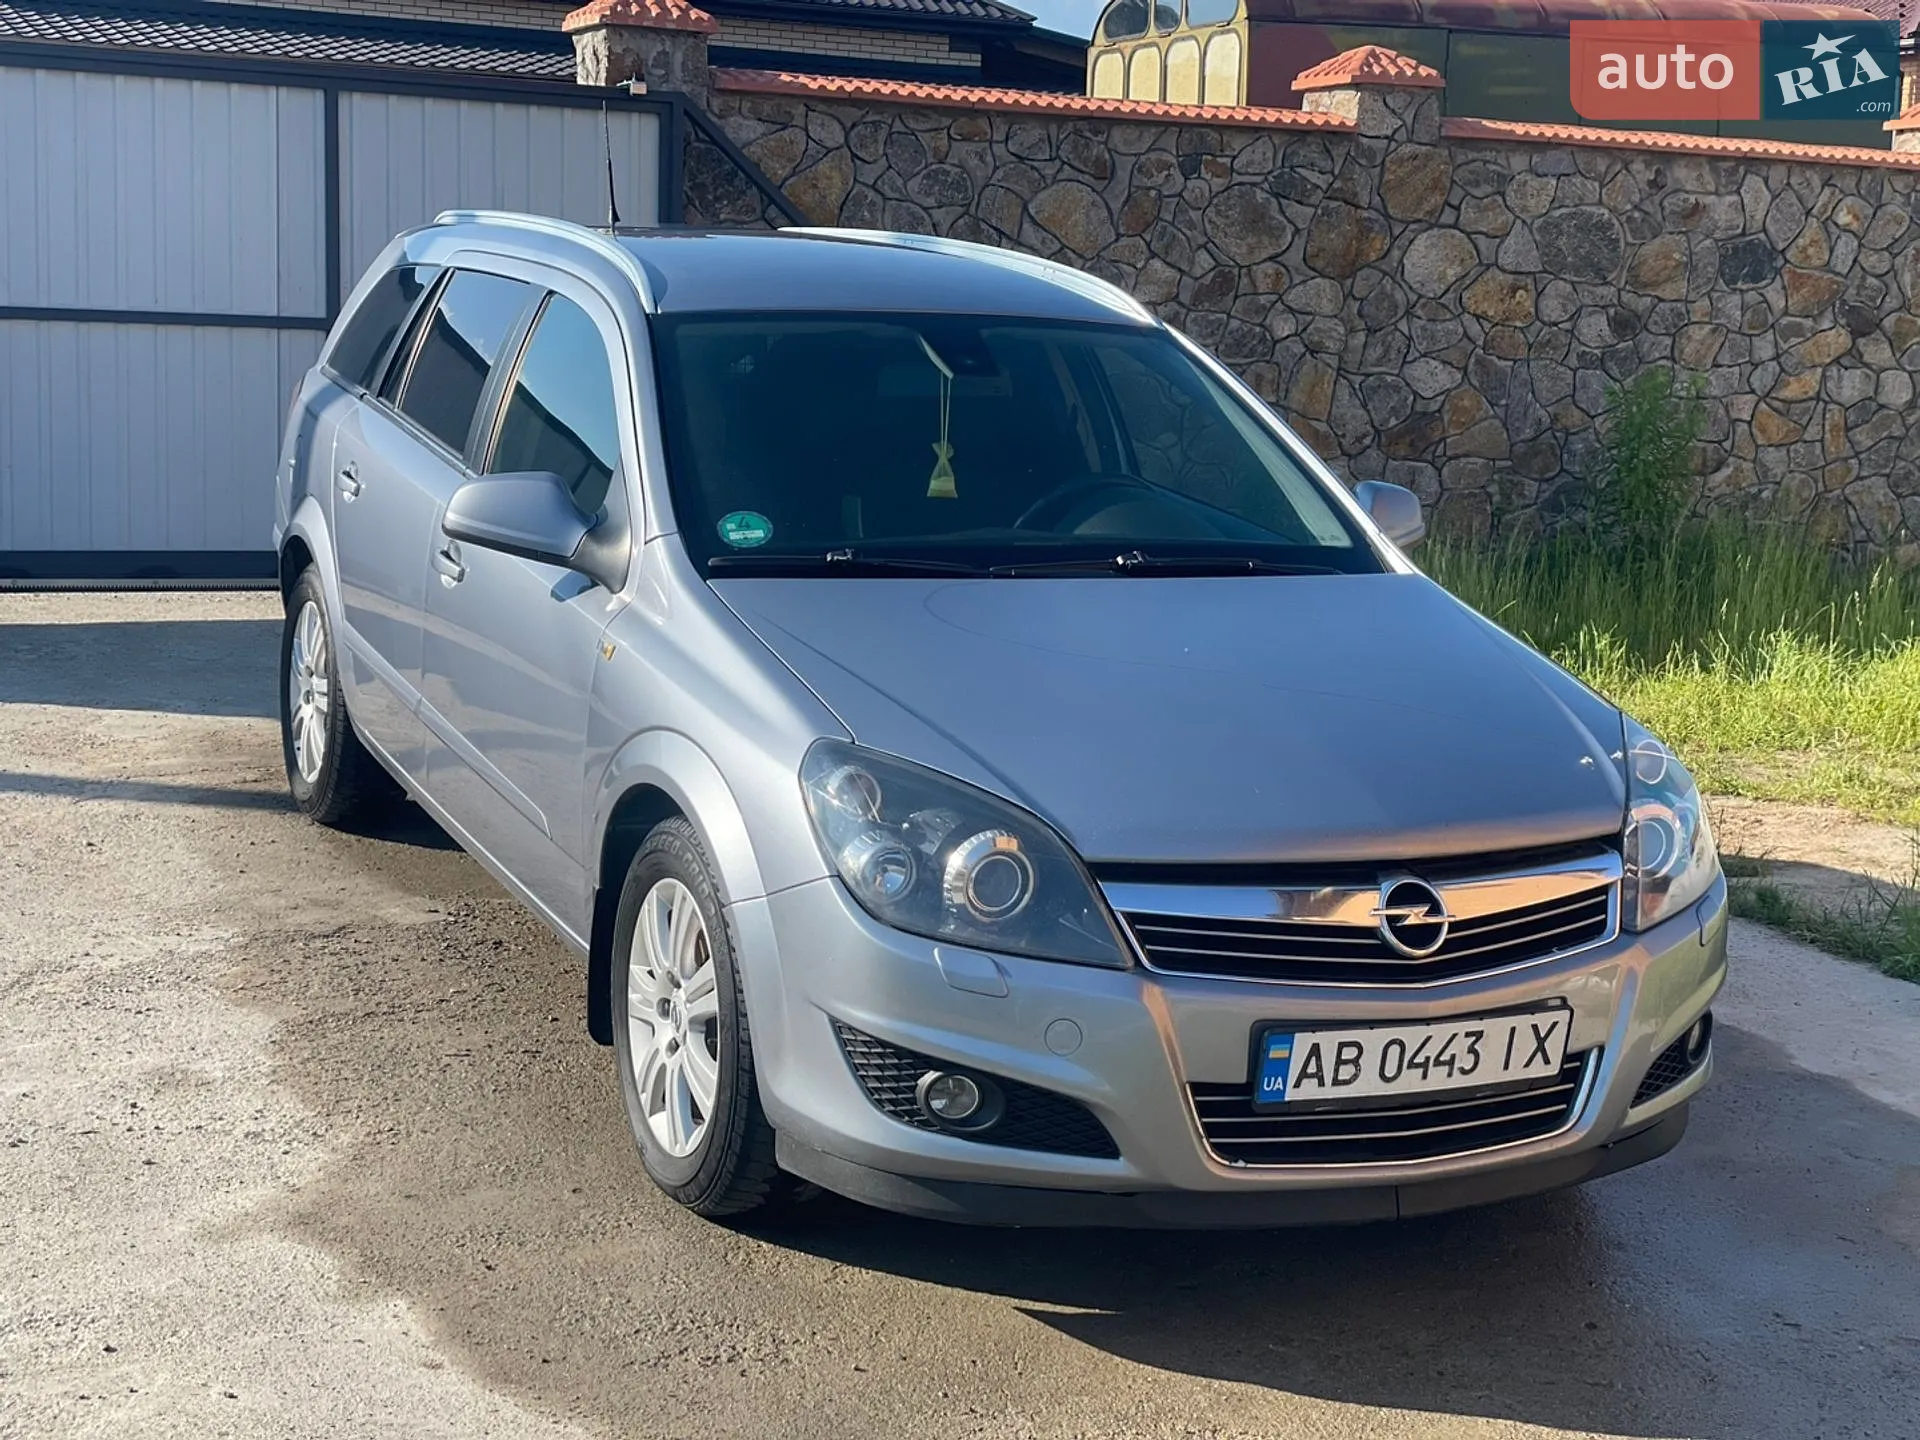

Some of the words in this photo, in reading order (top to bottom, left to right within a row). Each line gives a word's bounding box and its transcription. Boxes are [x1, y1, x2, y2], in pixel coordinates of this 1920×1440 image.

[1292, 1040, 1364, 1089] AB
[1378, 1030, 1484, 1083] 0443
[1502, 1021, 1560, 1072] IX
[1263, 1076, 1283, 1091] UA
